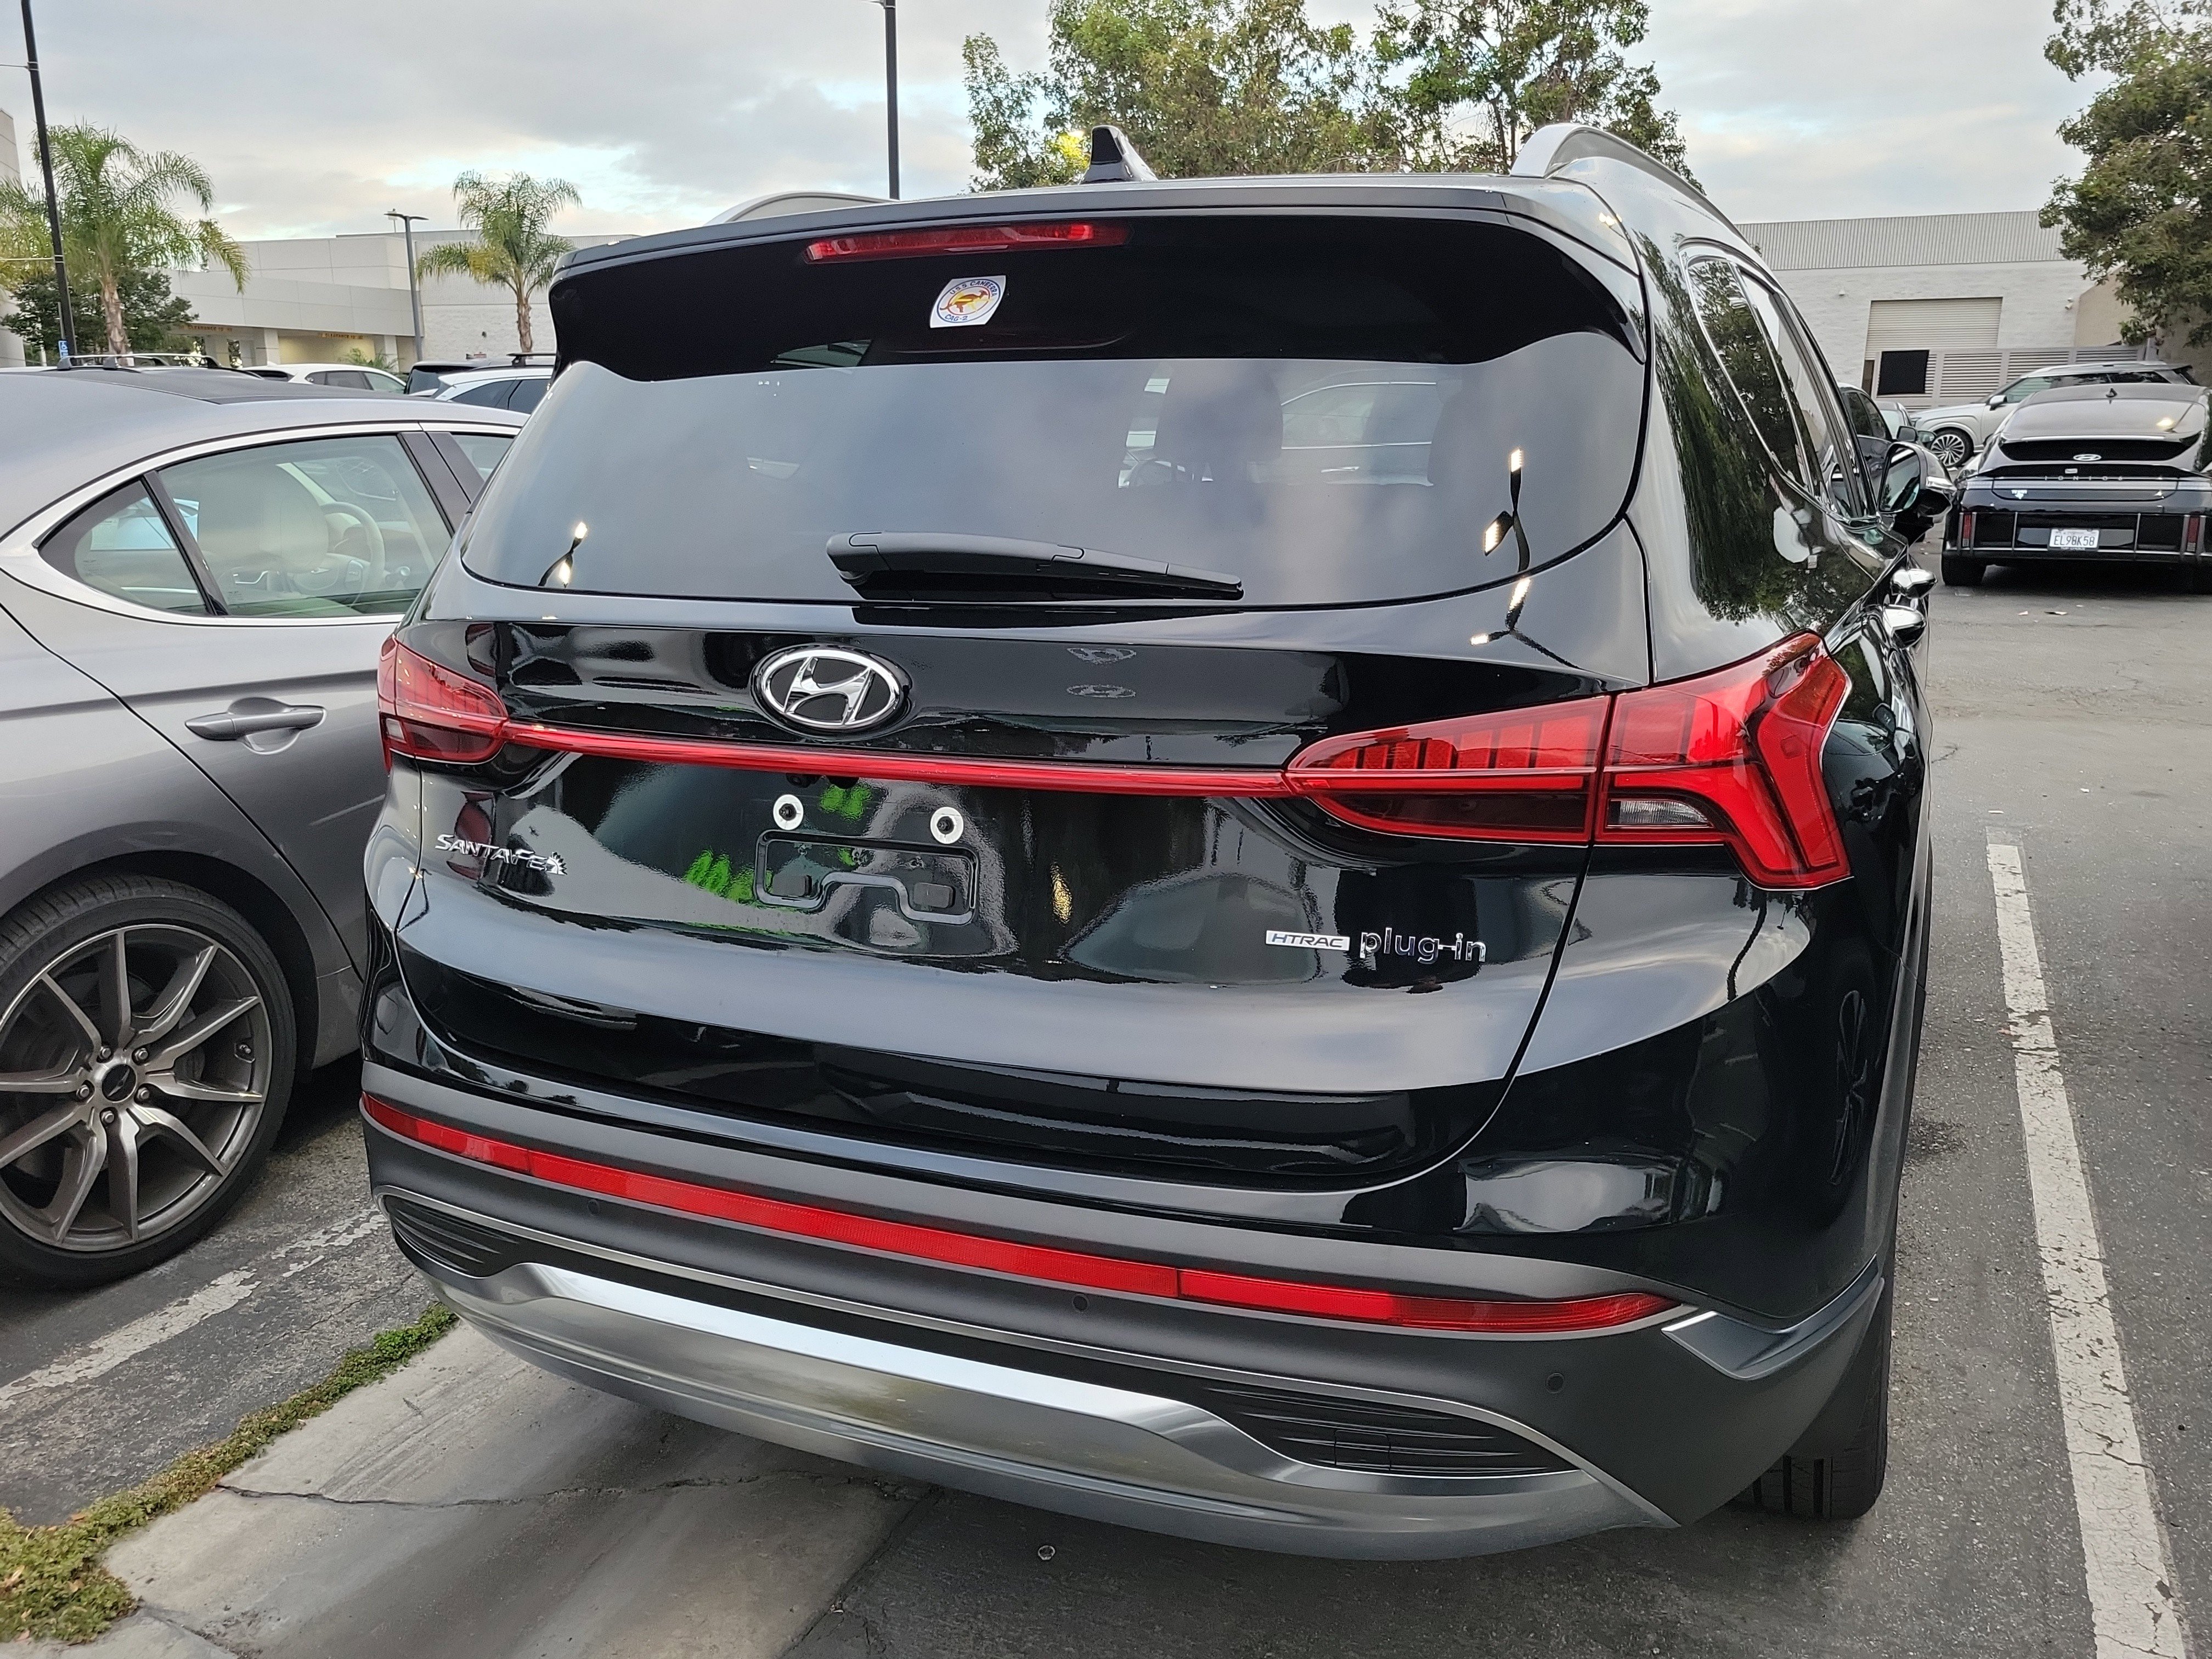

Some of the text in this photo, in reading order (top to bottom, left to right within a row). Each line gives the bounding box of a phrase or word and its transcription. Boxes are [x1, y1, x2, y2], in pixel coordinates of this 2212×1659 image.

[970, 280, 997, 297] CANBERRA
[2053, 535, 2095, 546] EL98K58
[1271, 927, 1487, 964] HTRAC plug-in
